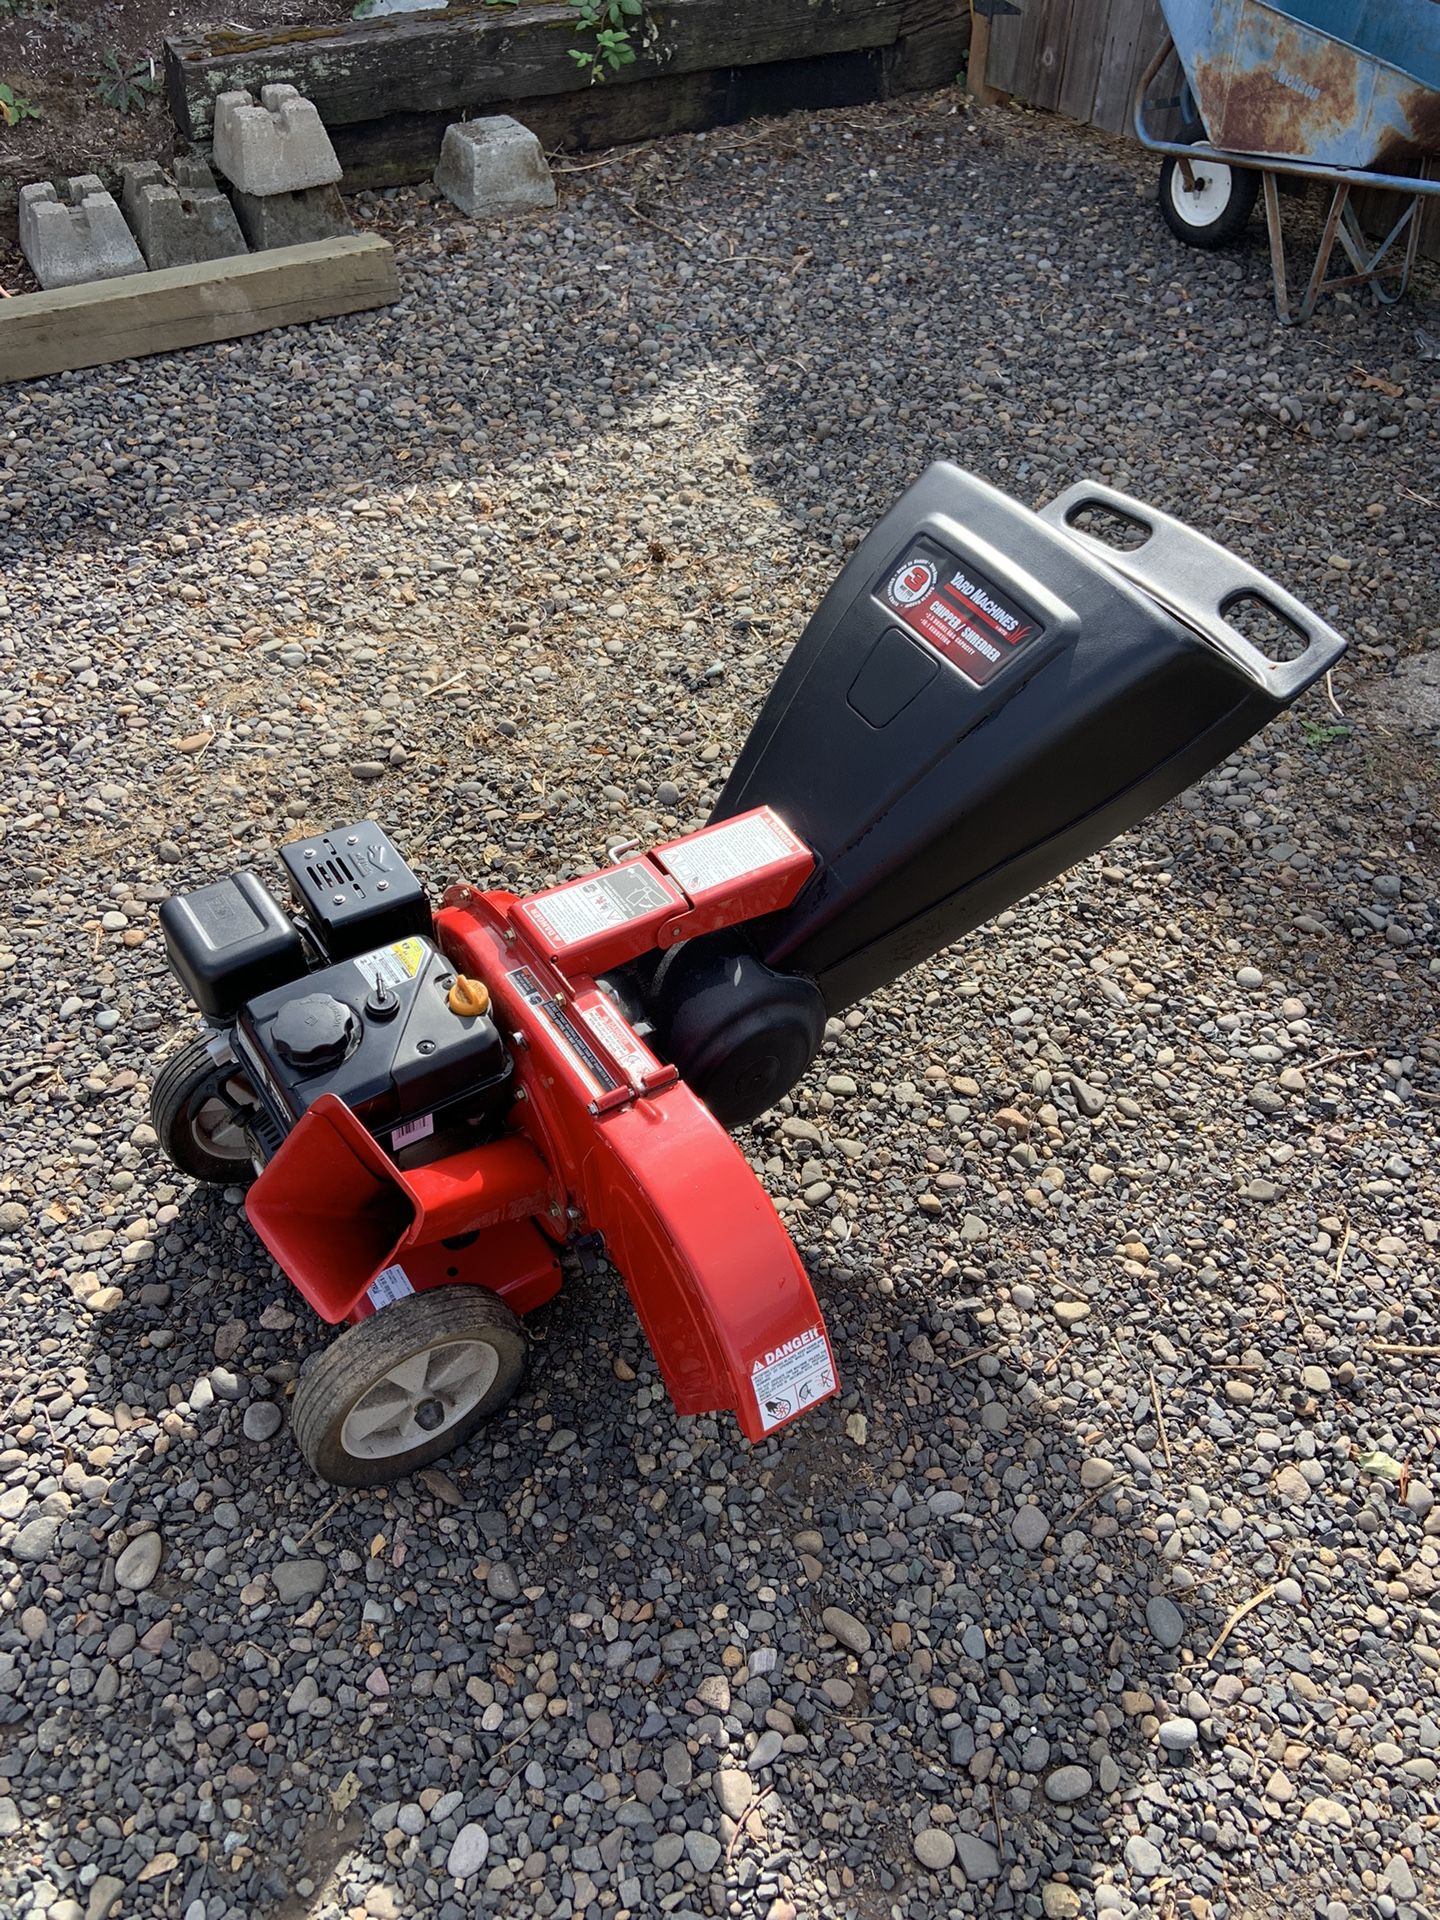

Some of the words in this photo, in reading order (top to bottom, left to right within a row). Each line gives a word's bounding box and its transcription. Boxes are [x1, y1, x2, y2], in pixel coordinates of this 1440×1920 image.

[903, 566, 929, 592] 3
[950, 572, 974, 596] YARD
[970, 589, 1018, 631] MACHINES
[930, 600, 961, 629] CHIPPER
[961, 625, 1001, 662] SHREDDER
[771, 822, 794, 847] DANGER
[533, 910, 555, 936] DANGER
[608, 1020, 629, 1044] DANGER
[765, 1328, 819, 1365] DANGER
